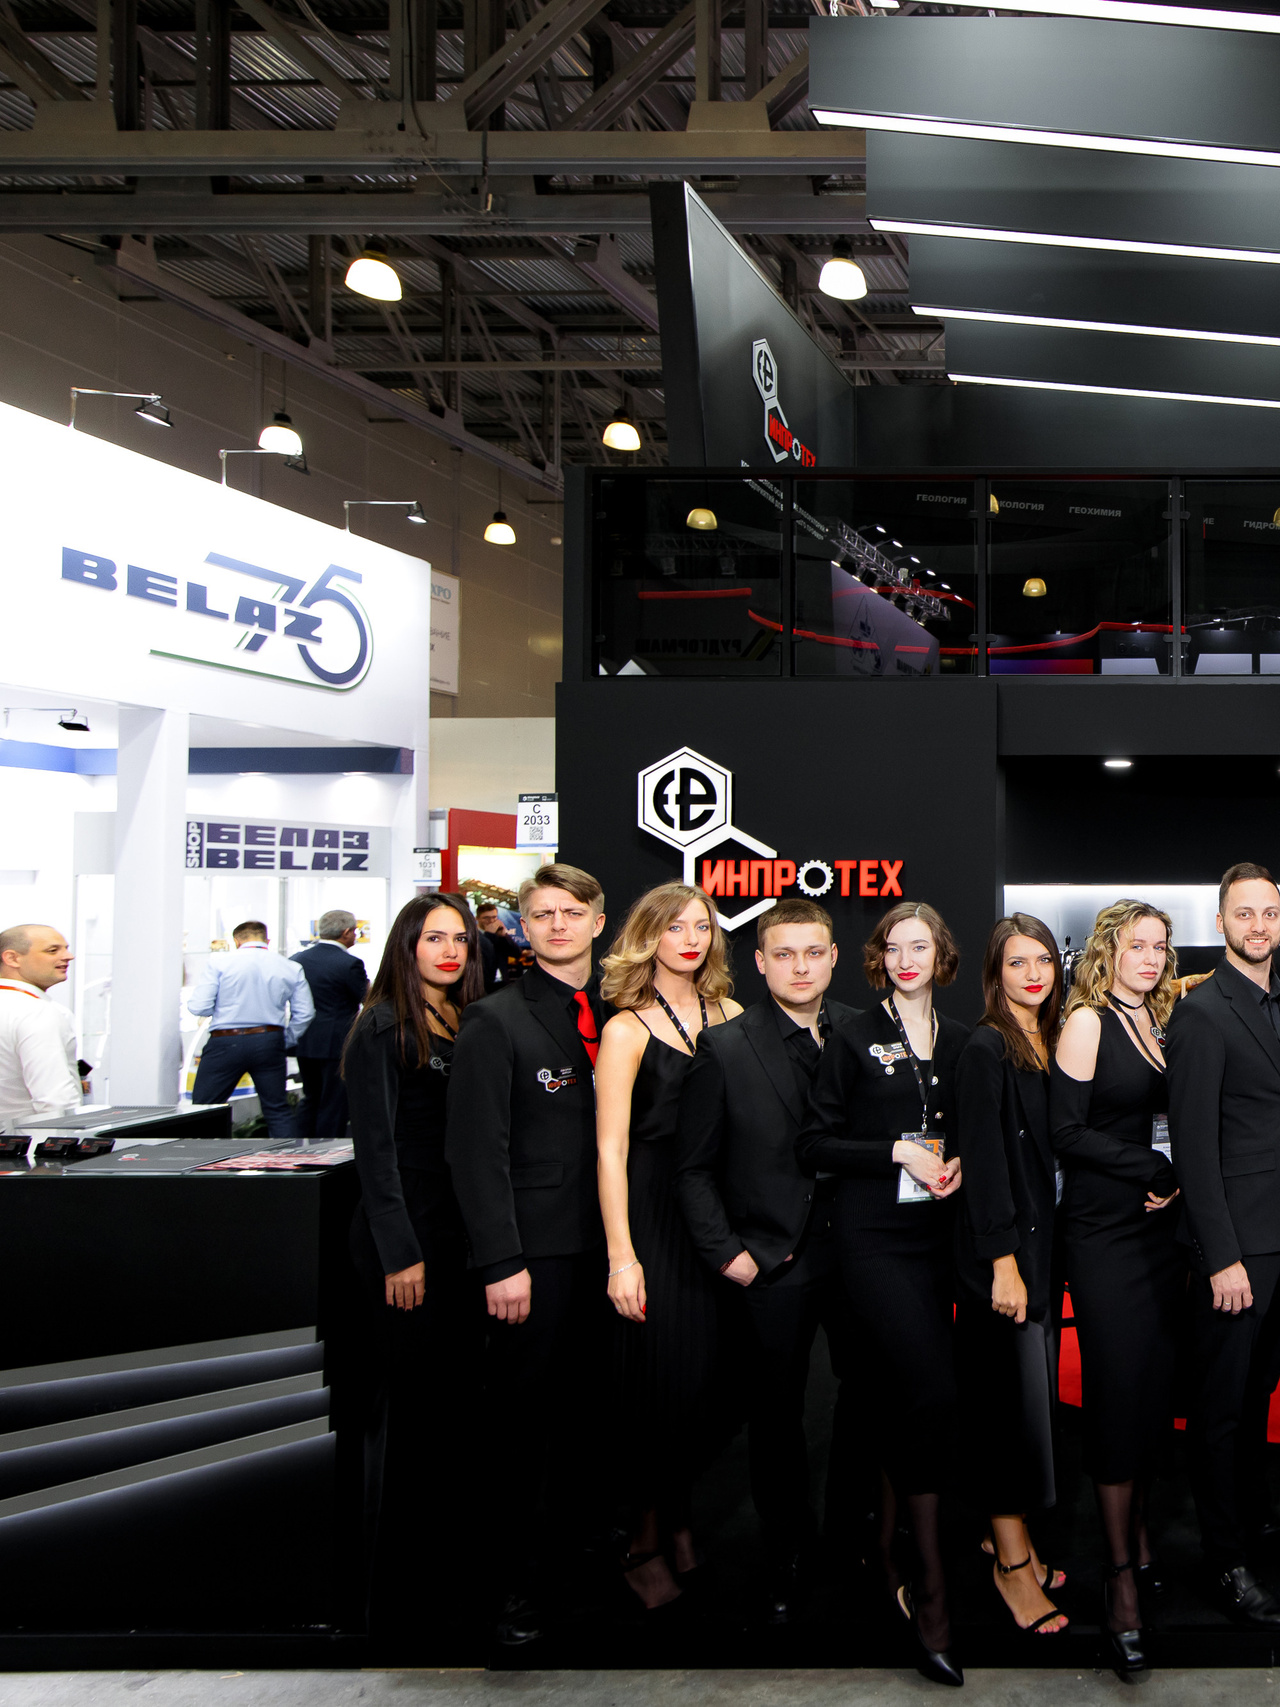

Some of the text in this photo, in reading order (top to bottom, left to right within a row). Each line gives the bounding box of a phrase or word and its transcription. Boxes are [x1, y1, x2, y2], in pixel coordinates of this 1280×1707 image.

[768, 414, 817, 467] ИНПРОТЕХ
[916, 494, 967, 505] ГЕОЛОГИЯ
[996, 500, 1045, 511] КОЛОГИЯ
[1068, 506, 1122, 517] ГЕОХИМИЯ
[61, 546, 323, 644] BELAZ
[523, 815, 551, 826] 2033
[187, 822, 202, 868] SHOP
[206, 822, 369, 850] БЕЛАЗ
[205, 848, 369, 871] BELAZ
[702, 859, 904, 898] ИНПРОТЕХ
